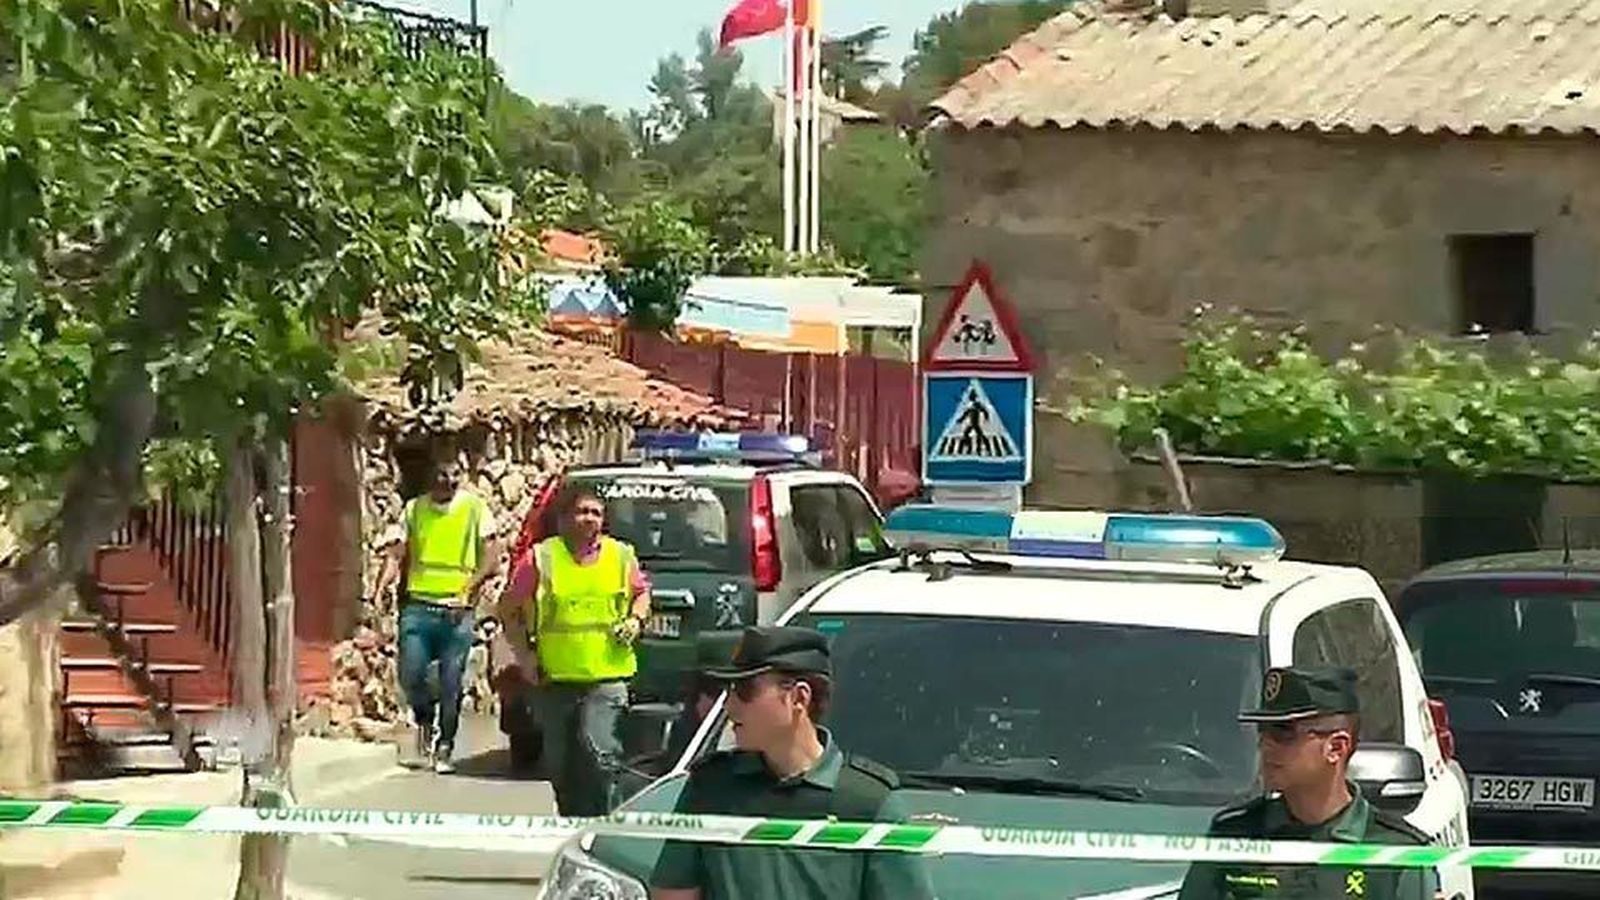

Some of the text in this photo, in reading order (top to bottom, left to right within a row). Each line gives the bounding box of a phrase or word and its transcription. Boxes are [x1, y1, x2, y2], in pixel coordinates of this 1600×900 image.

[1480, 779, 1585, 802] 3267 HGW
[256, 807, 370, 822] GUARDIA
[382, 810, 445, 825] CIVIL
[981, 827, 1076, 846] GUARDIA
[1086, 831, 1138, 849] CIVIL
